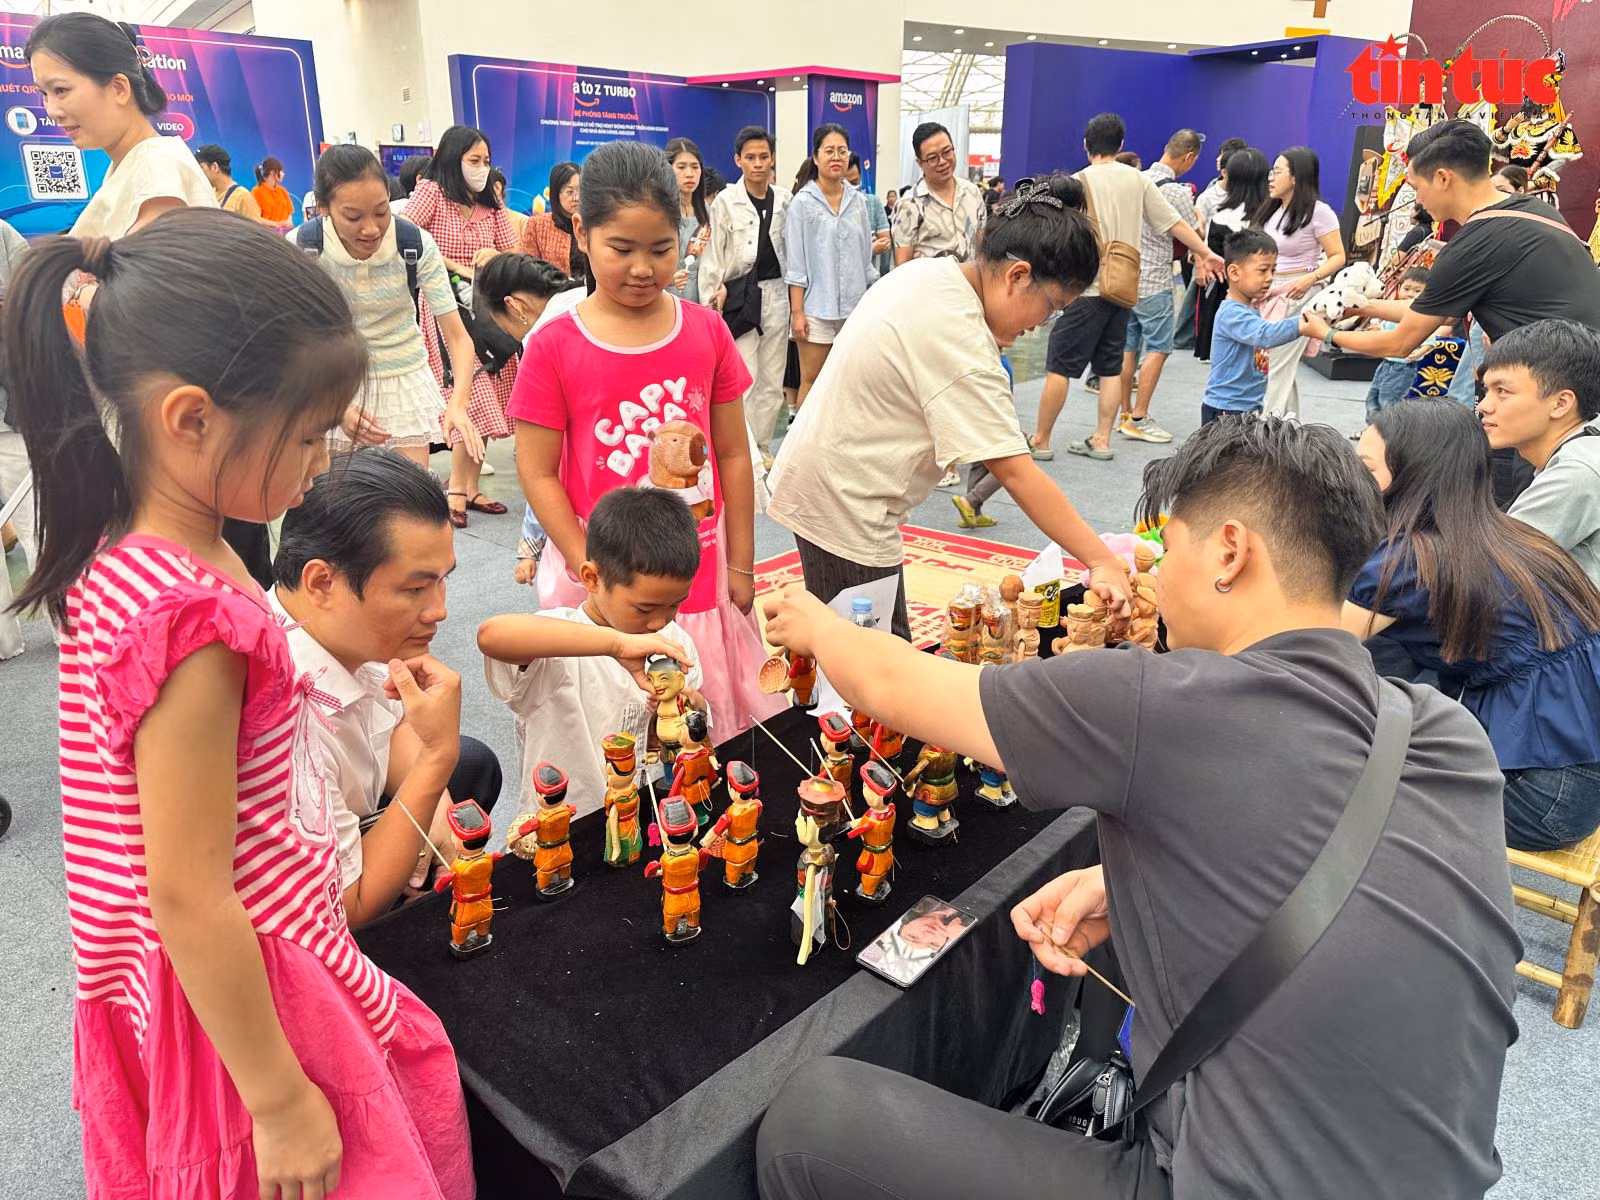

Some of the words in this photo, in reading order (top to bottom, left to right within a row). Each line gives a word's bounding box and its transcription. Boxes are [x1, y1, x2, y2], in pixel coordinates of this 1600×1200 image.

[143, 54, 187, 71] ation
[572, 81, 580, 94] a
[581, 80, 594, 95] to
[603, 84, 637, 98] TURBO
[829, 91, 863, 105] amazon
[156, 122, 185, 131] VIDEO
[594, 376, 687, 446] CAPY
